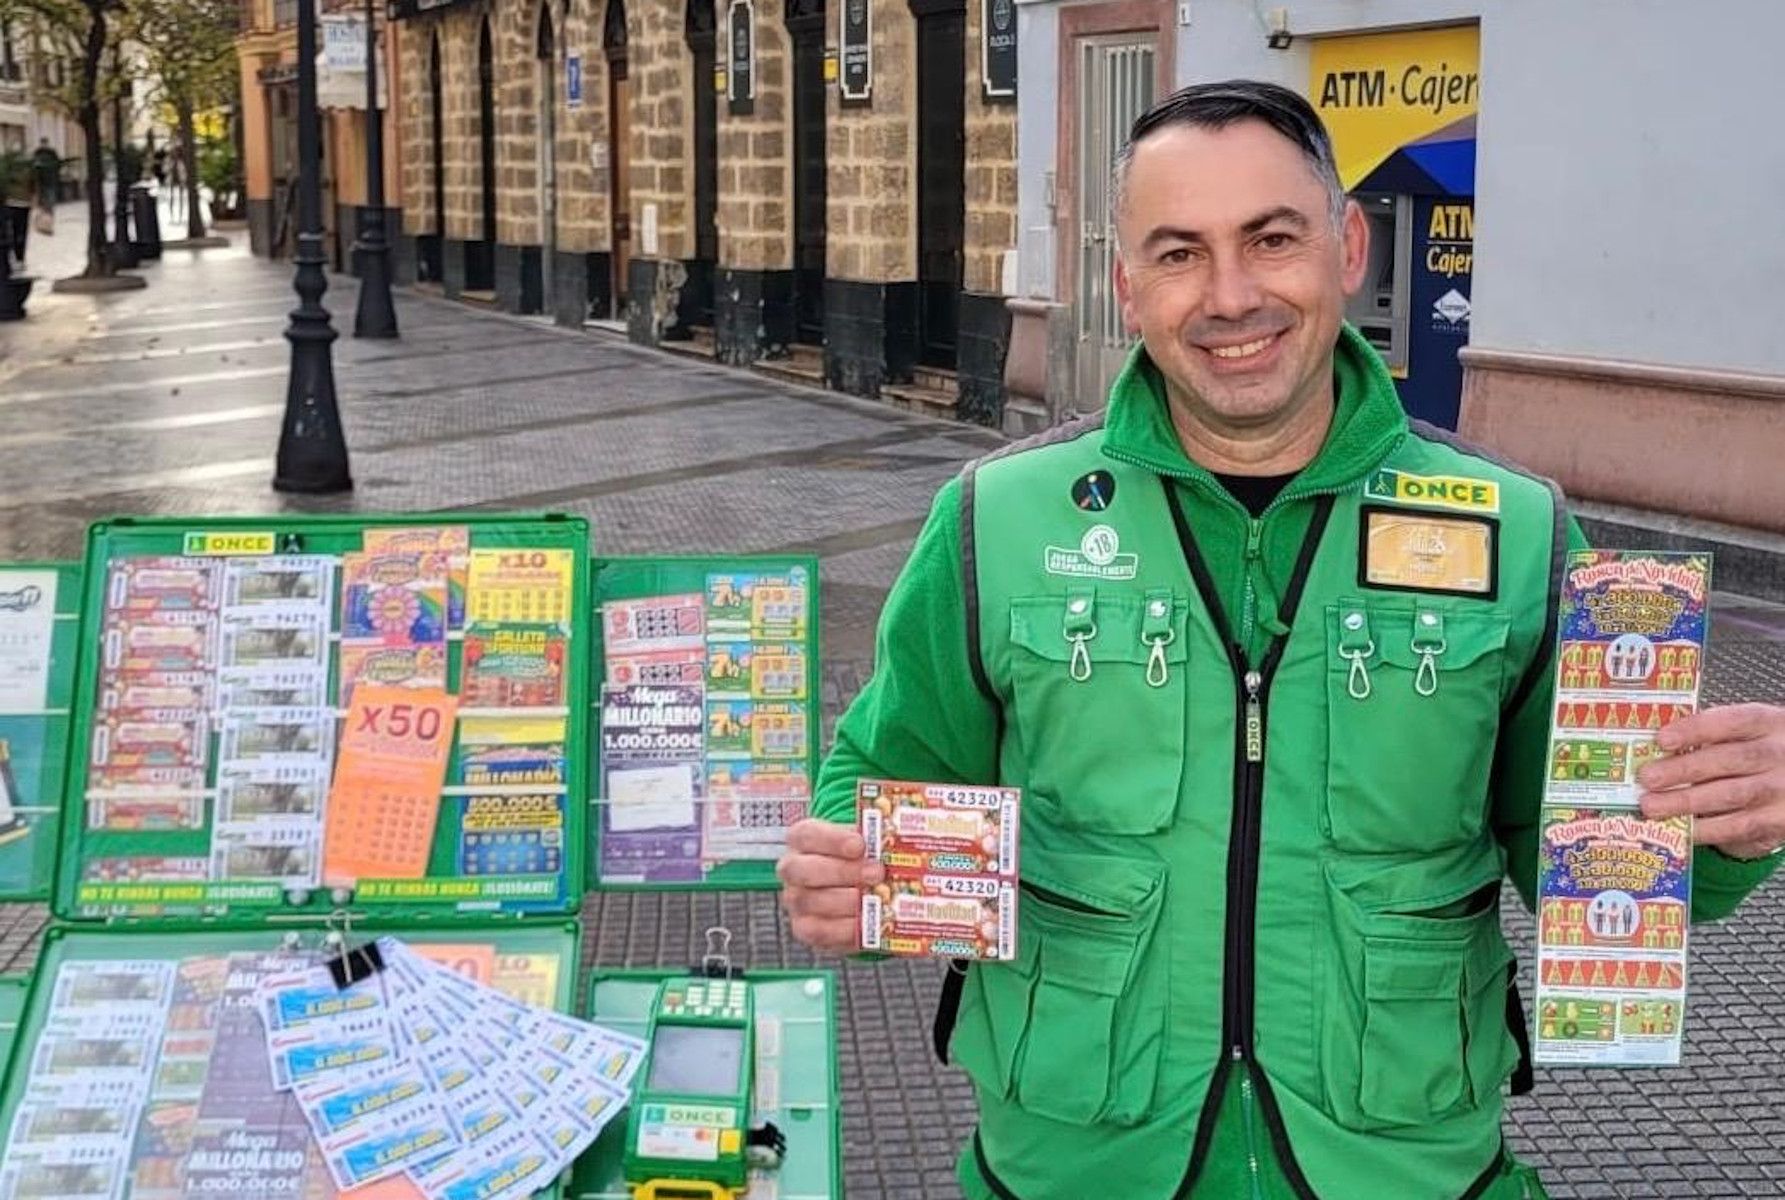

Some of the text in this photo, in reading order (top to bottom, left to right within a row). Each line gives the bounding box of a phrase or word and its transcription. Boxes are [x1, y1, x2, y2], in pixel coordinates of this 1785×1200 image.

[1320, 70, 1385, 108] ATM
[1404, 480, 1488, 504] ONCE
[211, 537, 269, 550] ONCE
[1574, 563, 1623, 586] Rasca
[1638, 560, 1703, 598] Navidad
[631, 687, 678, 709] Mega
[604, 705, 702, 727] MILLONARIO
[605, 733, 702, 748] 1.000.000€
[1249, 720, 1259, 757] ONCE
[946, 792, 998, 806] 42320
[1550, 820, 1602, 842] Rasca
[1616, 816, 1685, 854] Navidad
[944, 880, 995, 894] 42320
[669, 1108, 727, 1123] ONCE
[223, 1132, 278, 1153] Mega
